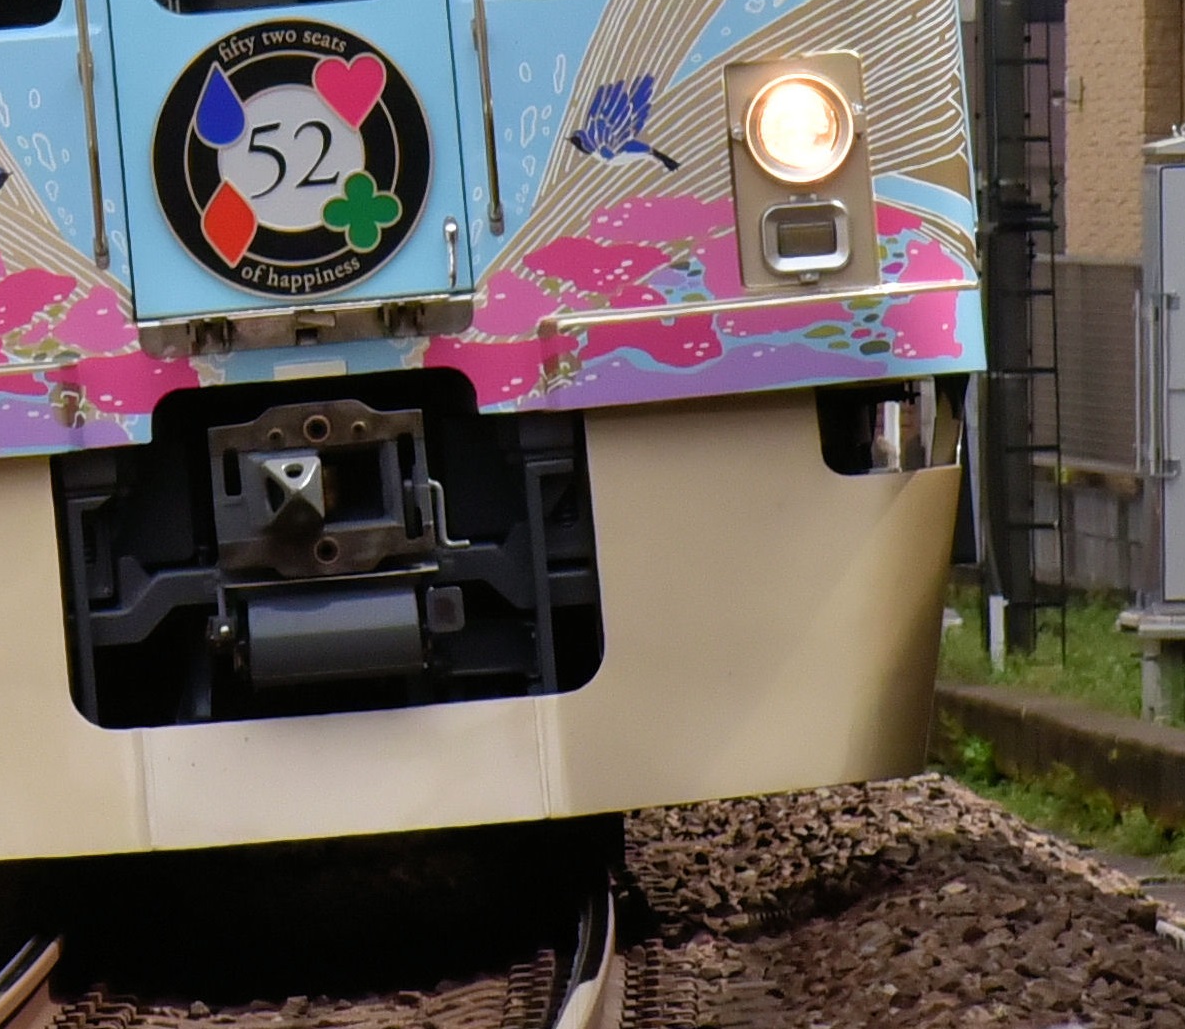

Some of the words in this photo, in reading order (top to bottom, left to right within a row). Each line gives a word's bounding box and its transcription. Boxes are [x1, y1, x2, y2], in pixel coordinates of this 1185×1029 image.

[218, 36, 255, 63] fifty
[261, 30, 296, 45] two
[302, 31, 347, 53] seats
[248, 120, 340, 199] 52
[241, 264, 267, 283] of
[266, 257, 361, 293] happiness
